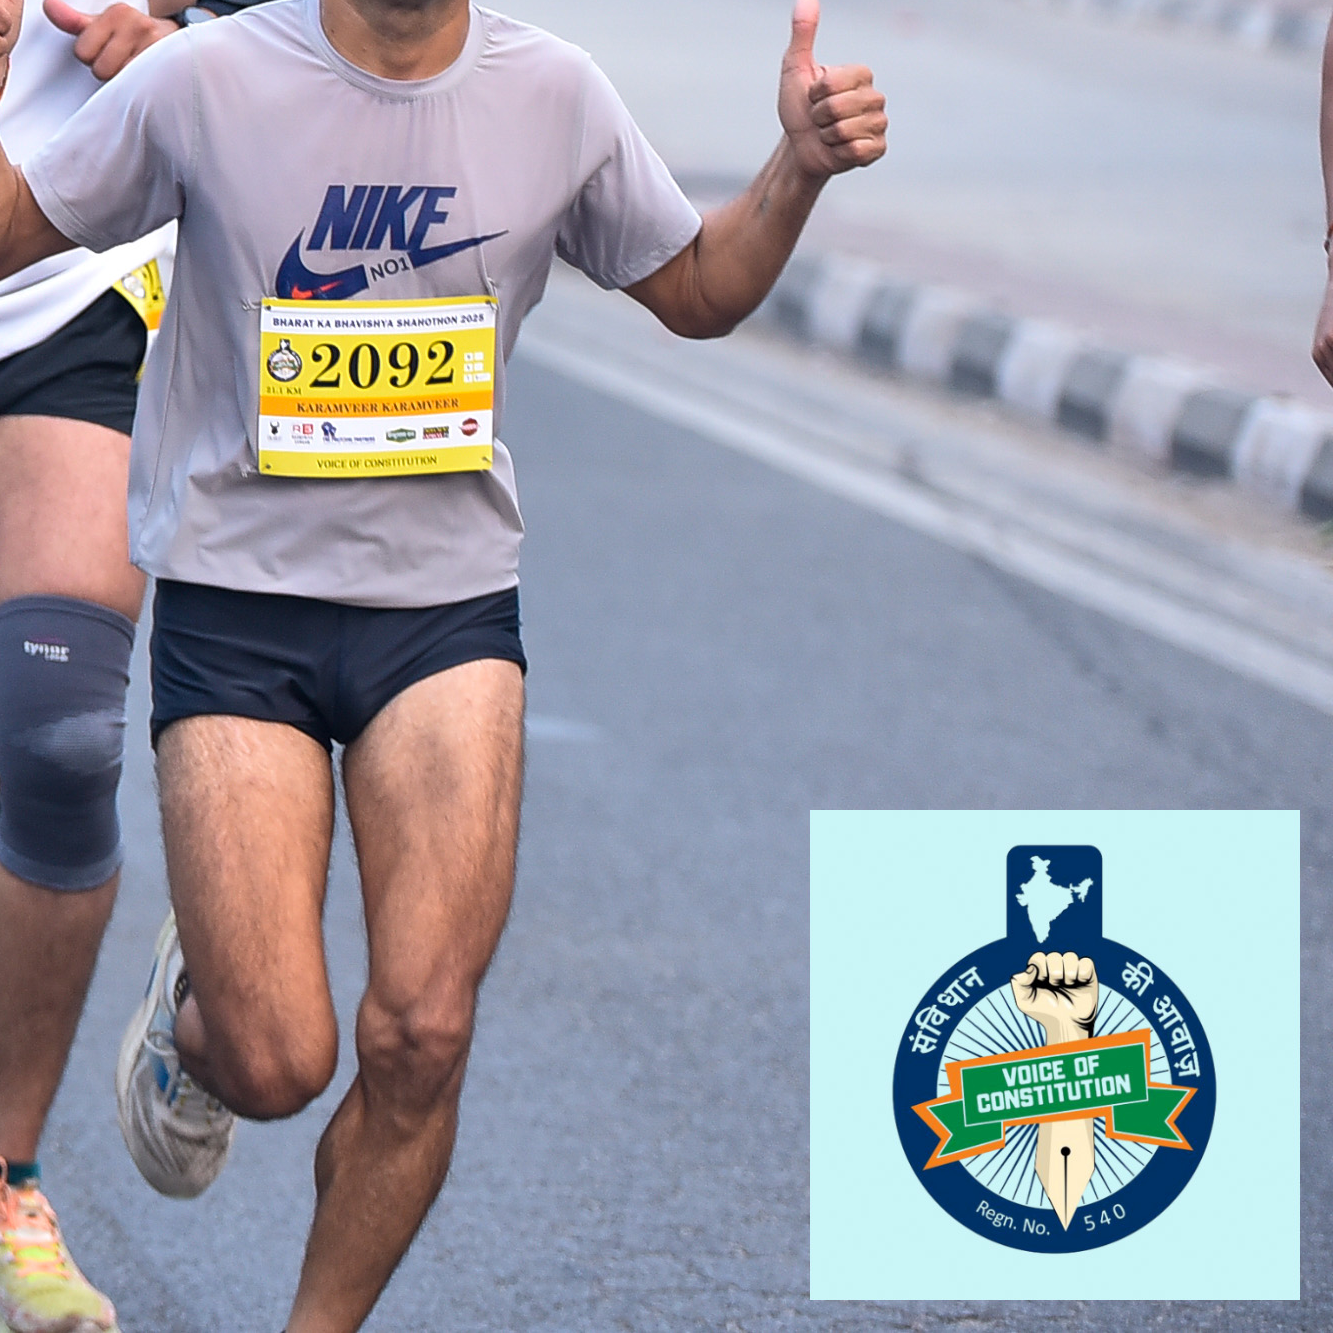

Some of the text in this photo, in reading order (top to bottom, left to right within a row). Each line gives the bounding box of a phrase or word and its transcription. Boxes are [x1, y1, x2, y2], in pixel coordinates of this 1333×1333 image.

[305, 184, 458, 251] NIKE
[369, 256, 411, 282] NO1
[272, 313, 485, 329] BHARAT KA BHAVISHYA SHAHOTHON 2025
[309, 339, 455, 389] 2092
[286, 386, 302, 396] KM
[296, 398, 460, 414] KARAMVEER KARAMVEER
[316, 455, 438, 470] VOICE OF CONSTITUTION
